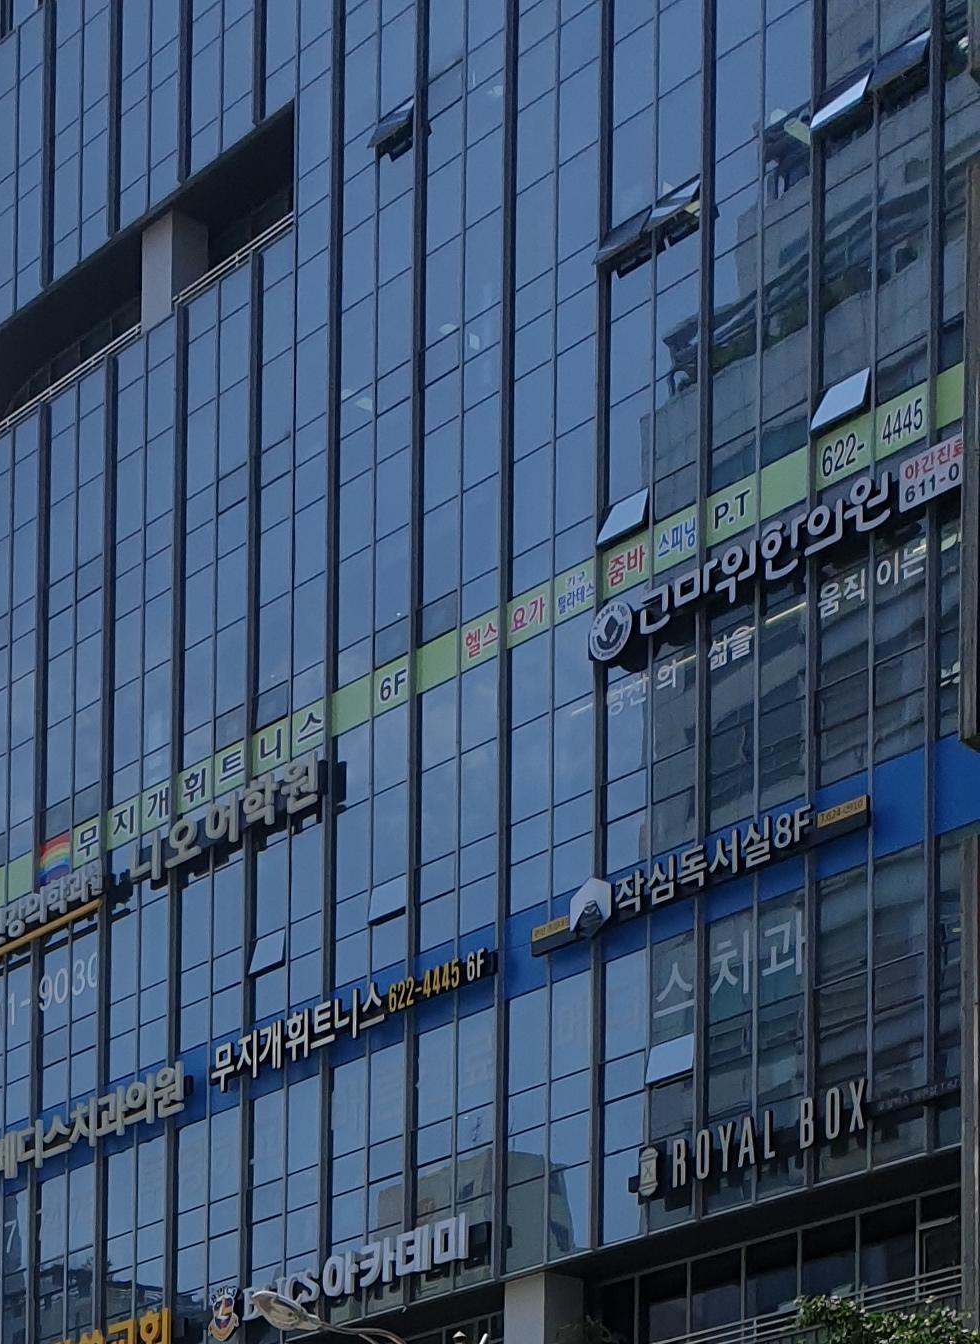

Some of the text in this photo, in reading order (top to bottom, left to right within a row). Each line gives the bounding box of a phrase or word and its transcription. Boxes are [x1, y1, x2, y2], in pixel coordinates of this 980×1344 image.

[608, 545, 646, 587] 줌바
[511, 597, 546, 633] 요가
[465, 622, 499, 658] 헬스
[379, 669, 408, 701] 6F
[76, 711, 325, 858] 무지개휘트니스
[211, 982, 385, 1092] 무지개휘트니스
[387, 957, 460, 1013] 622-4445
[672, 1110, 776, 1188] ROYAL
[799, 1077, 868, 1149] BOX
